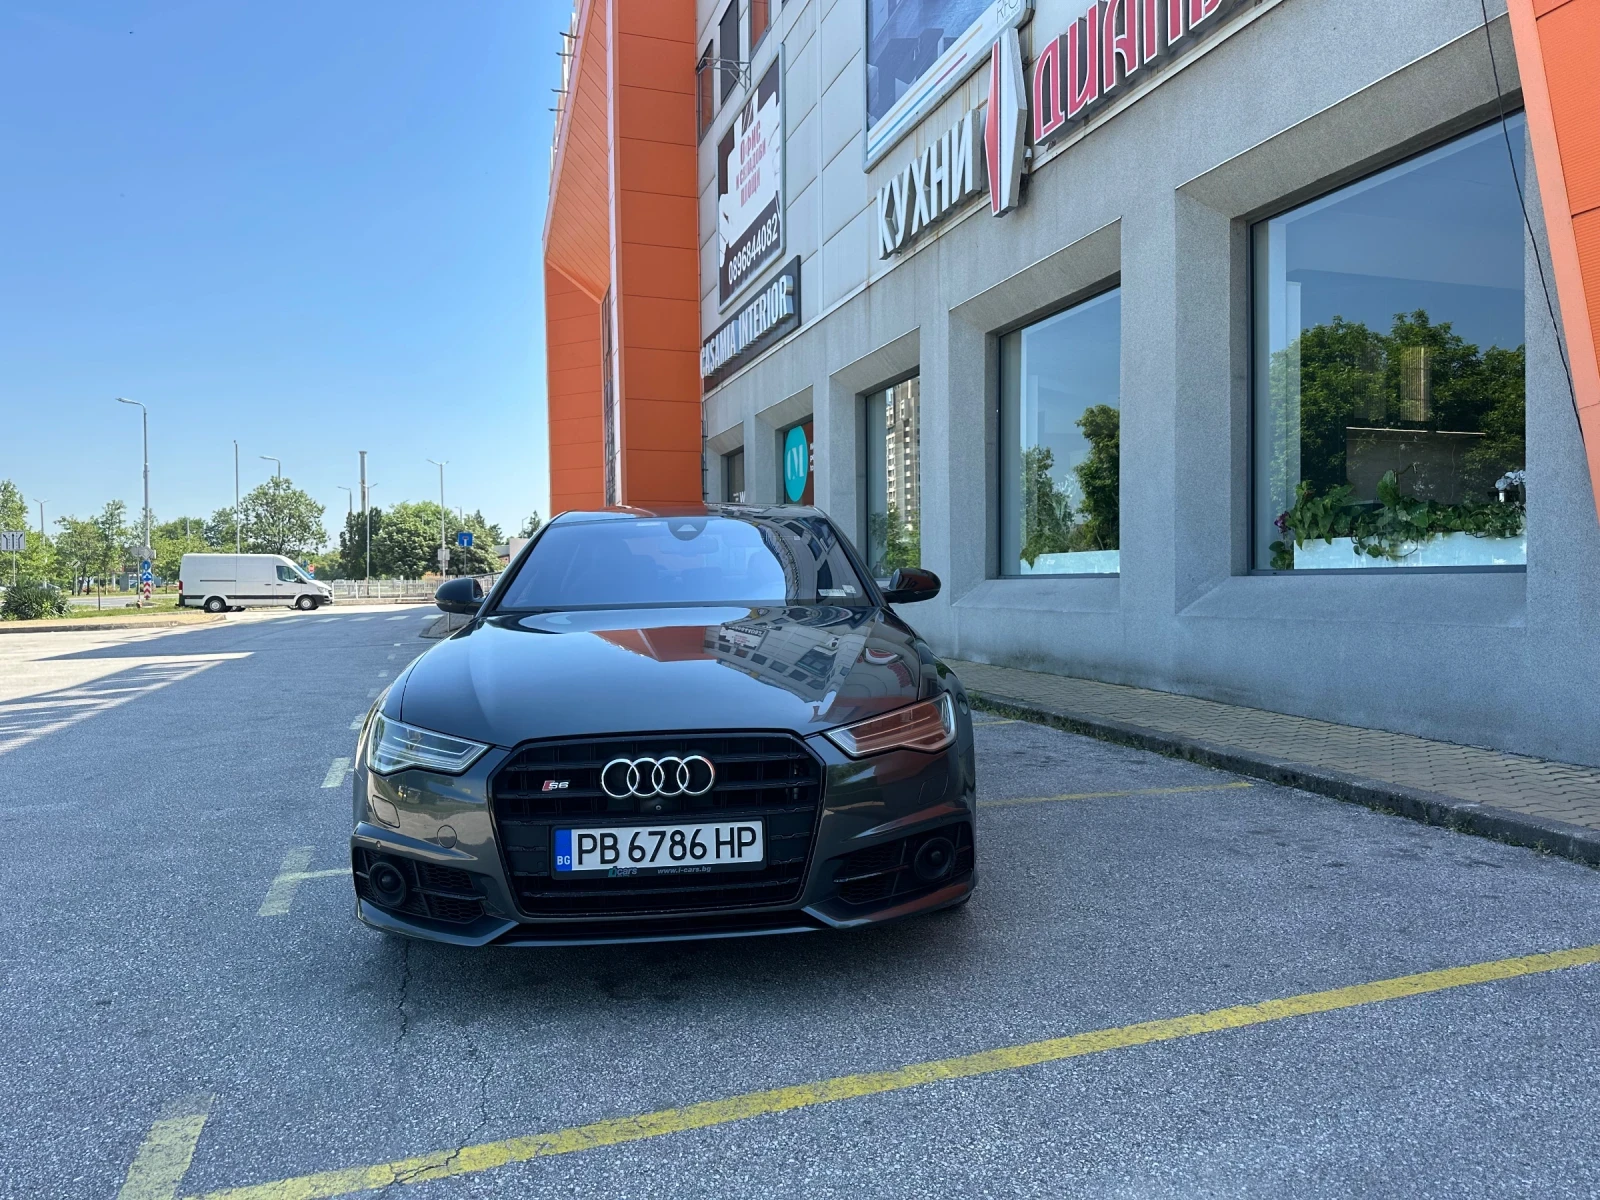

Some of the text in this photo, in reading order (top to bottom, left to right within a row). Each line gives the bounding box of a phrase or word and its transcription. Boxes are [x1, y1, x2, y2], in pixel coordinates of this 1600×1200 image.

[877, 108, 979, 260] КУХНИ
[728, 212, 778, 285] 0896844082
[700, 275, 791, 379] CASAMIA INTERIOR
[556, 855, 571, 866] BG
[577, 826, 757, 865] PB 6786 HP
[657, 865, 712, 875] www.i-cars.bg
